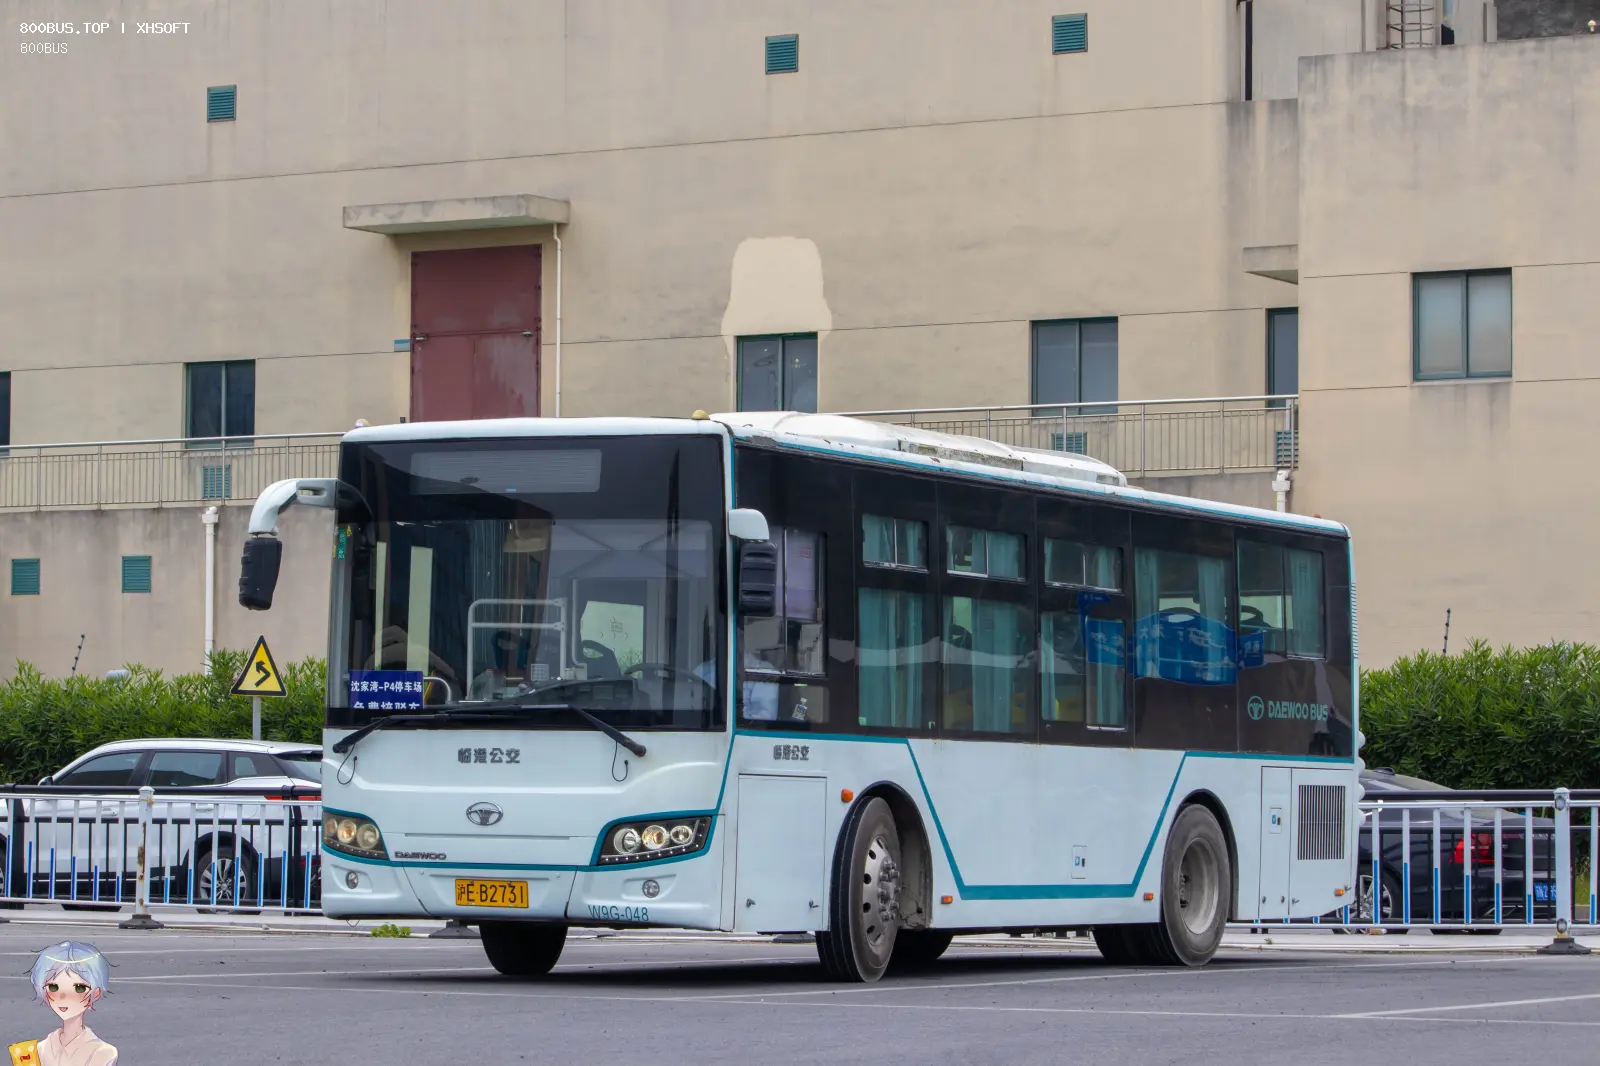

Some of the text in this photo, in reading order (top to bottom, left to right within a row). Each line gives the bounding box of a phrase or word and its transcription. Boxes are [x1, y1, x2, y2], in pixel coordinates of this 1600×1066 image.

[350, 680, 422, 693] 沈家湾-P4停车场
[1268, 700, 1329, 721] DAEWOO BUS
[457, 747, 521, 764] 临港公交
[394, 850, 447, 860] DAEWOO
[588, 904, 650, 922] W9G-048
